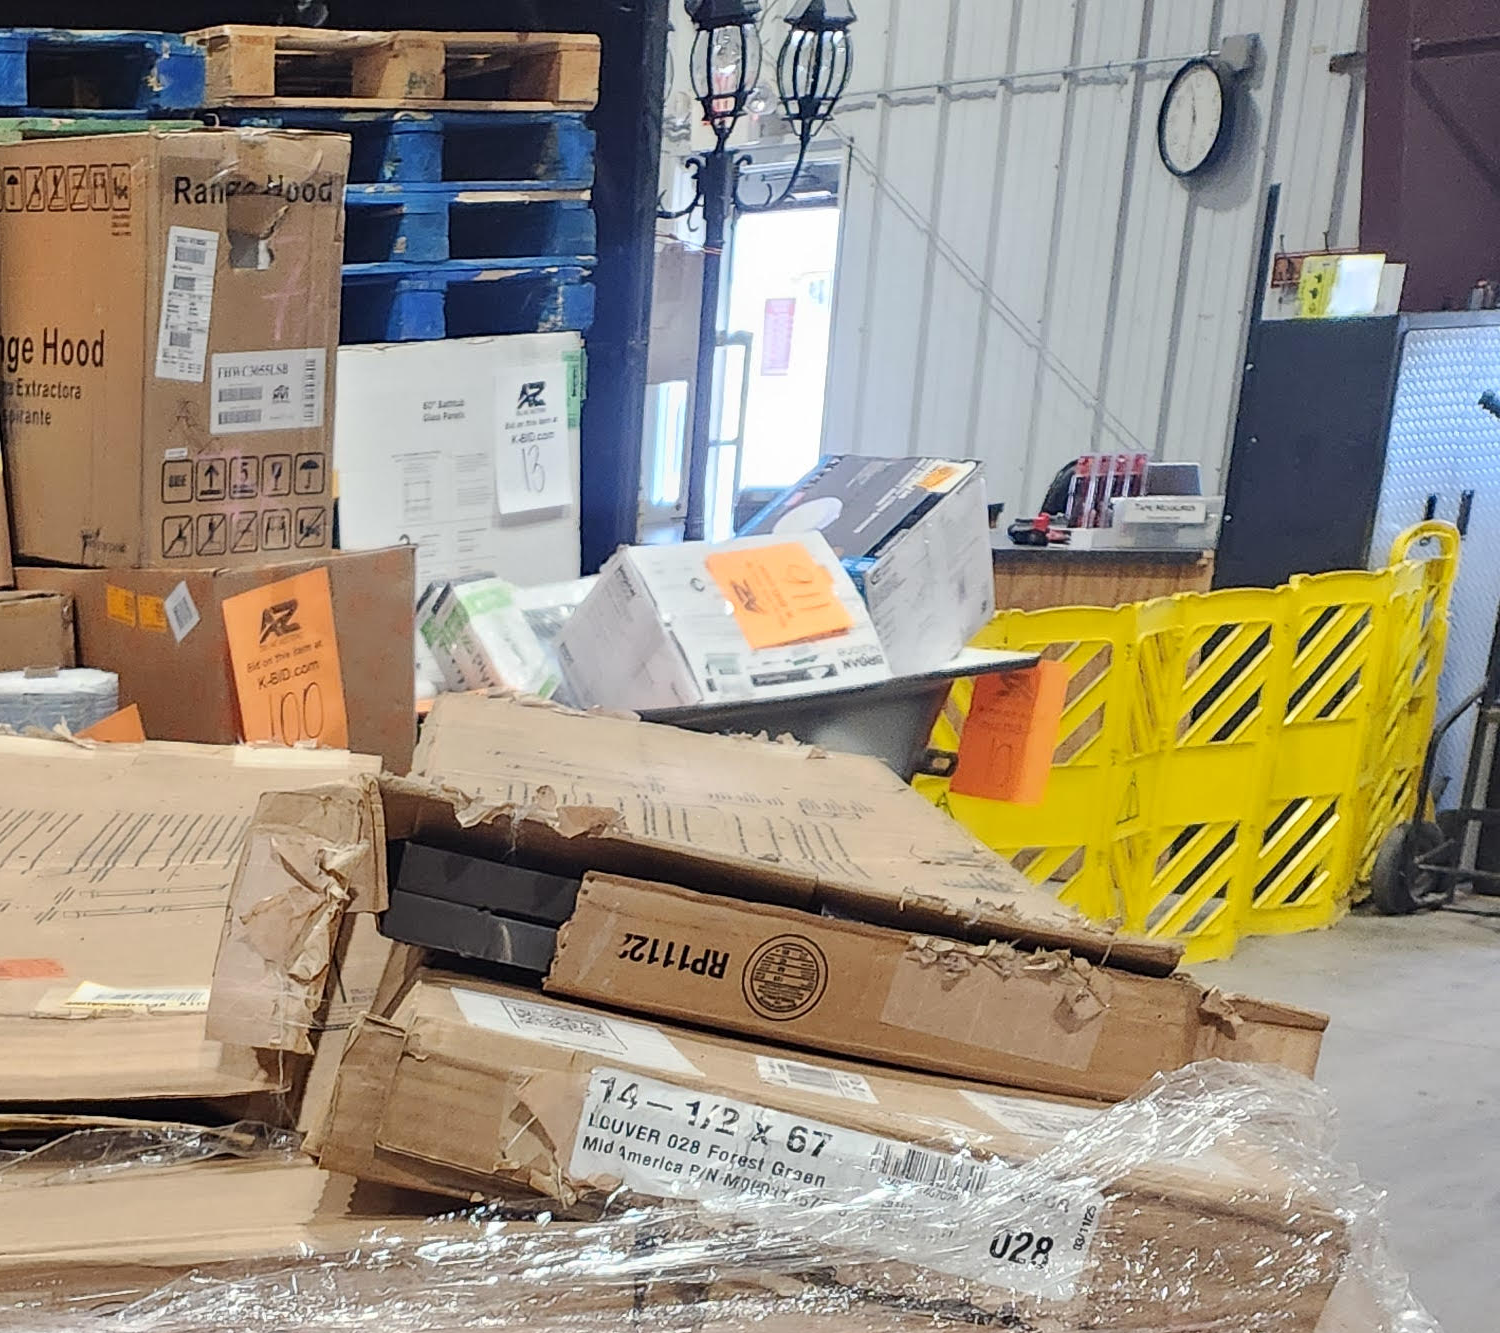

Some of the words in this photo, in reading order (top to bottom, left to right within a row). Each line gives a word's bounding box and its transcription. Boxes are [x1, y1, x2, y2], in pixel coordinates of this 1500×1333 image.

[42, 326, 105, 368] Hood
[16, 378, 81, 400] Extractora
[1, 408, 52, 426] spirante
[257, 660, 320, 690] K-BID.com
[269, 681, 324, 748] 100
[600, 1076, 638, 1111] 14
[685, 1100, 740, 1136] 1/2
[751, 1121, 772, 1146] x
[786, 1125, 833, 1158] 67
[582, 1135, 614, 1154] Mid
[618, 1145, 683, 1175] America
[689, 1163, 717, 1183] P/N
[587, 1112, 661, 1145] LOUVER
[667, 1134, 701, 1155] 028
[707, 1144, 765, 1172] Forest
[771, 1161, 826, 1188] Green
